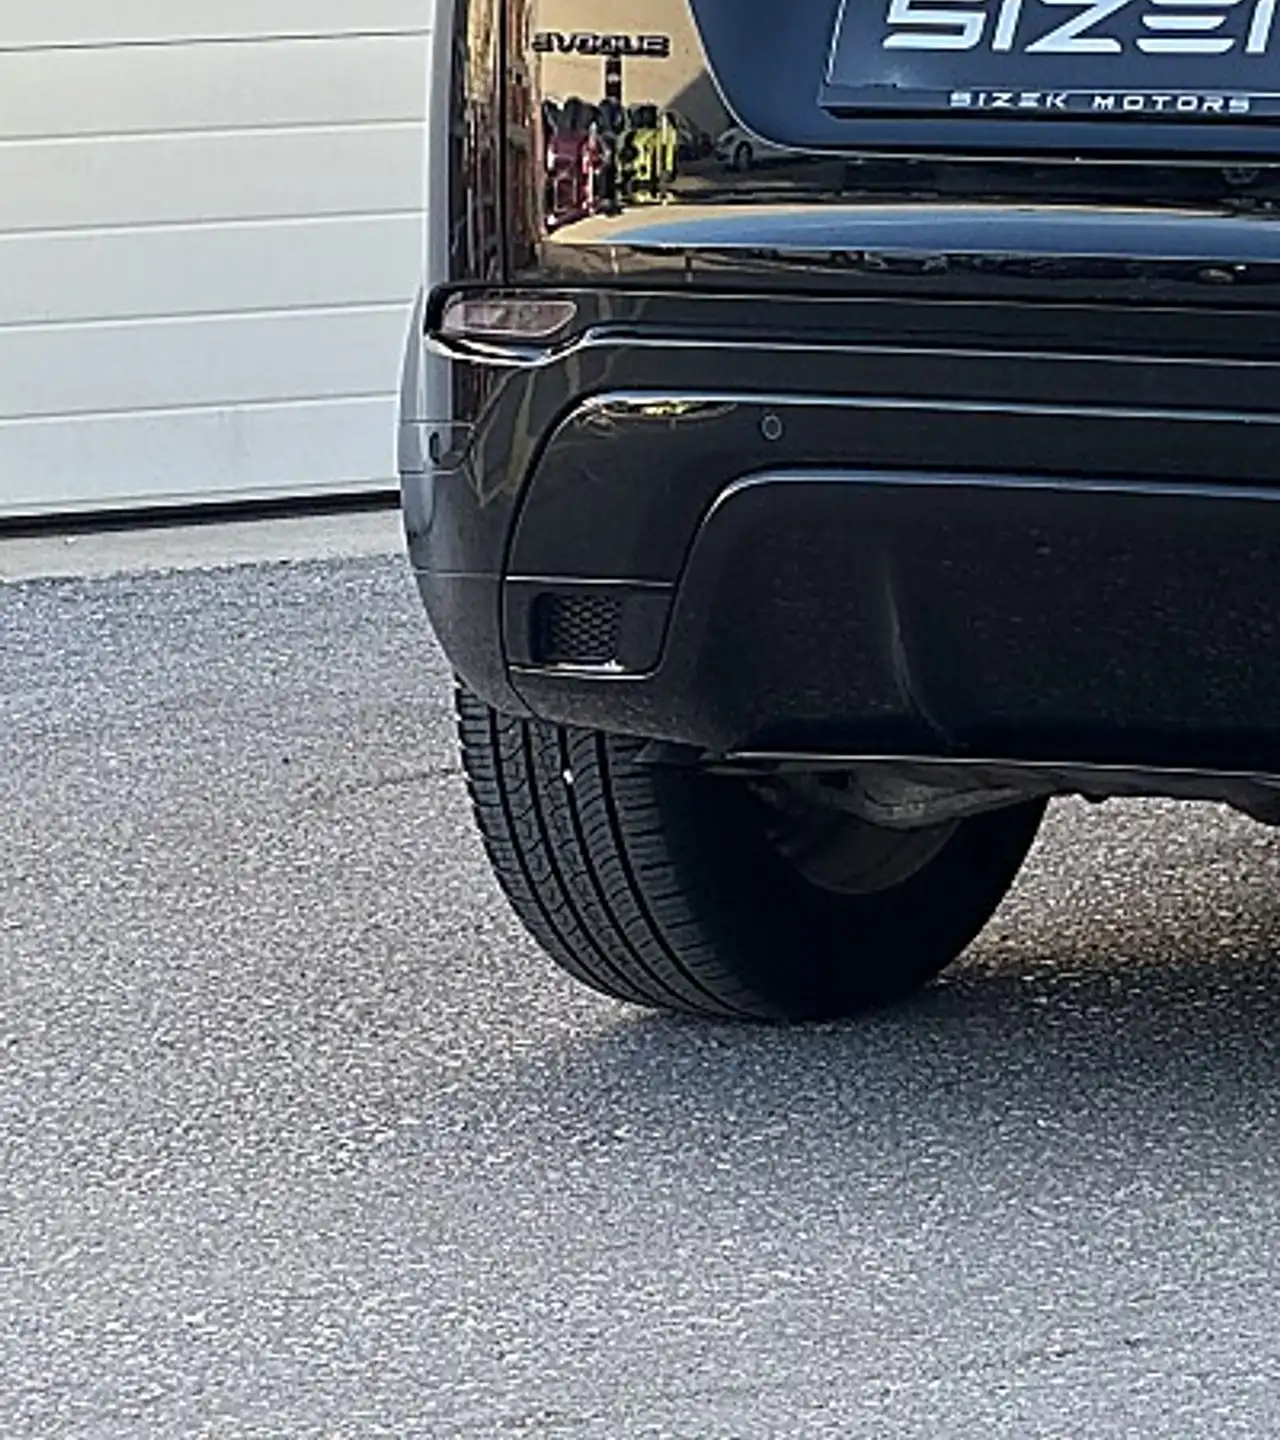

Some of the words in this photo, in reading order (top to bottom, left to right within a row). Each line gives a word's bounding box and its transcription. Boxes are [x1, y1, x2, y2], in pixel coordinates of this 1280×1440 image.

[531, 32, 670, 58] EVOQUE
[949, 91, 1068, 109] SIZEK
[1091, 93, 1250, 113] MOTORS
